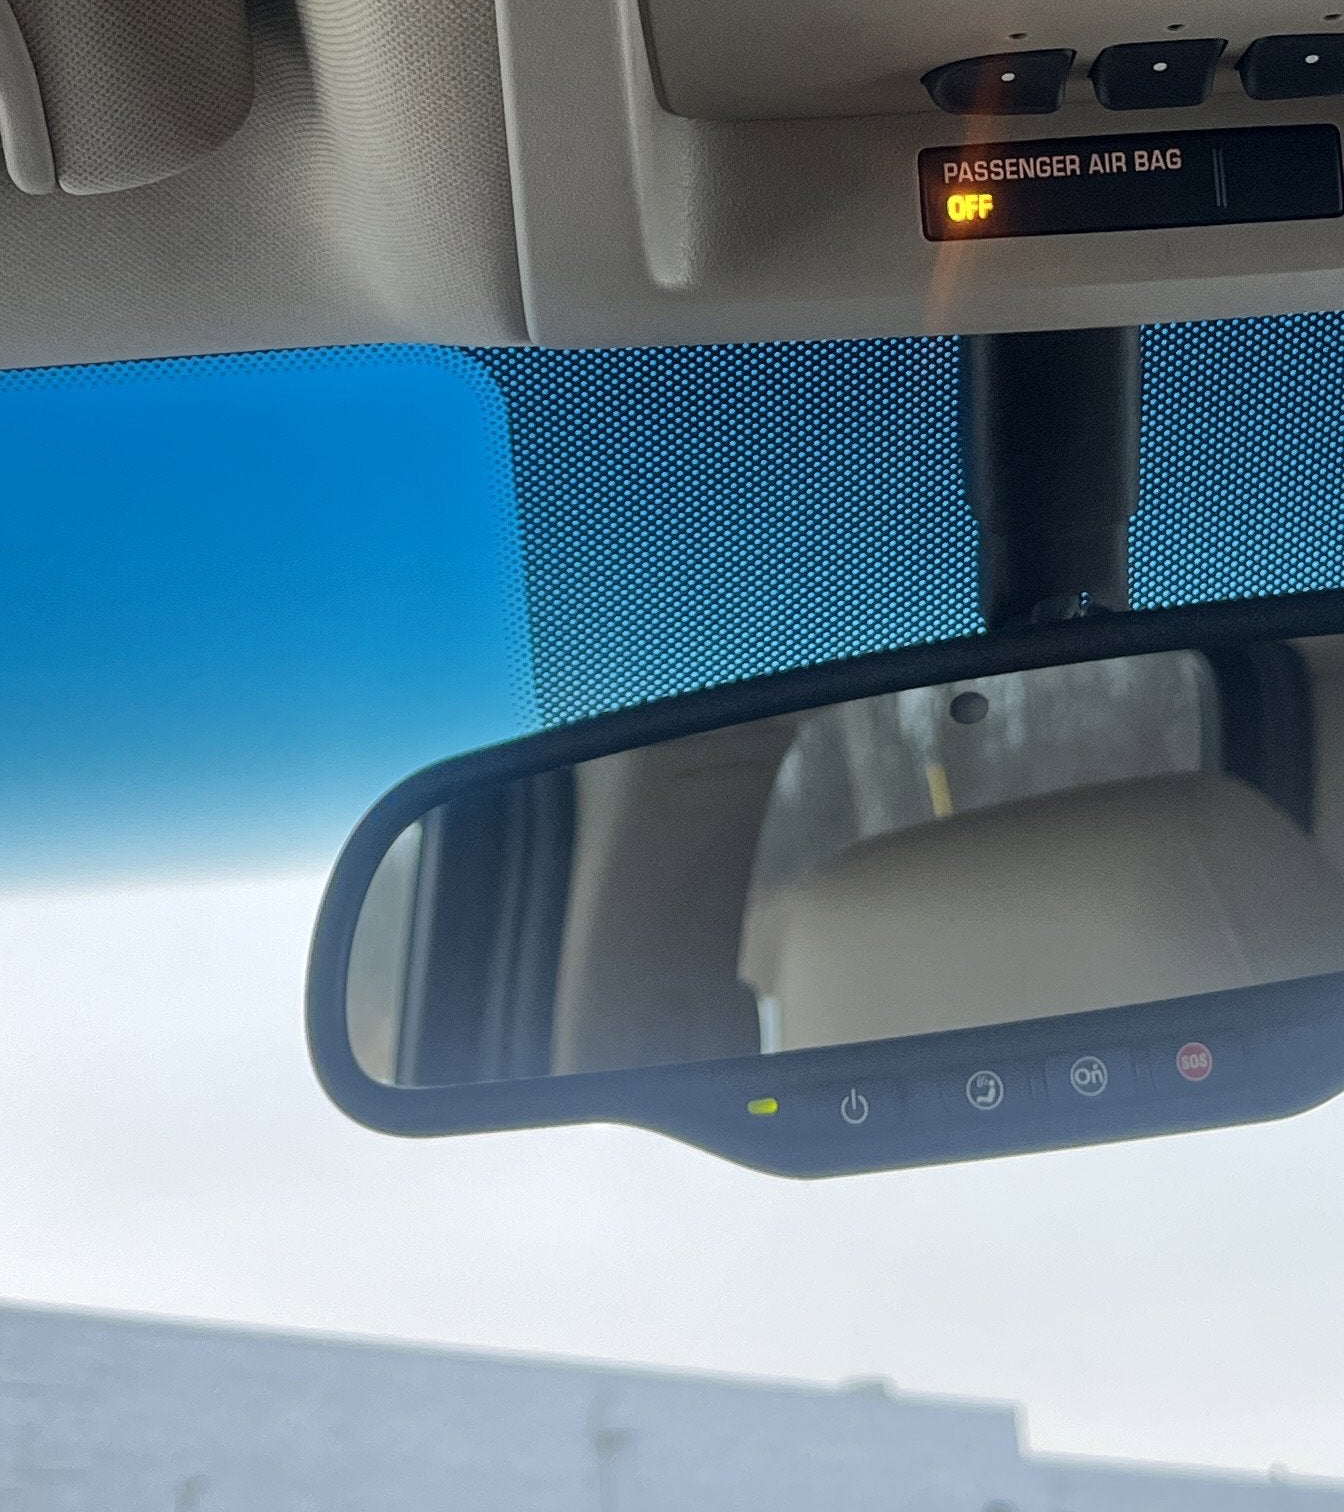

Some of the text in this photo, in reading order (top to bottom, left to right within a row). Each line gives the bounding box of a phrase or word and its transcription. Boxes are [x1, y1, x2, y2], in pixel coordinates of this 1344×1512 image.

[943, 148, 1182, 184] PASSENGER AIR BAG
[946, 193, 994, 222] OFF
[1181, 1052, 1208, 1070] SOS
